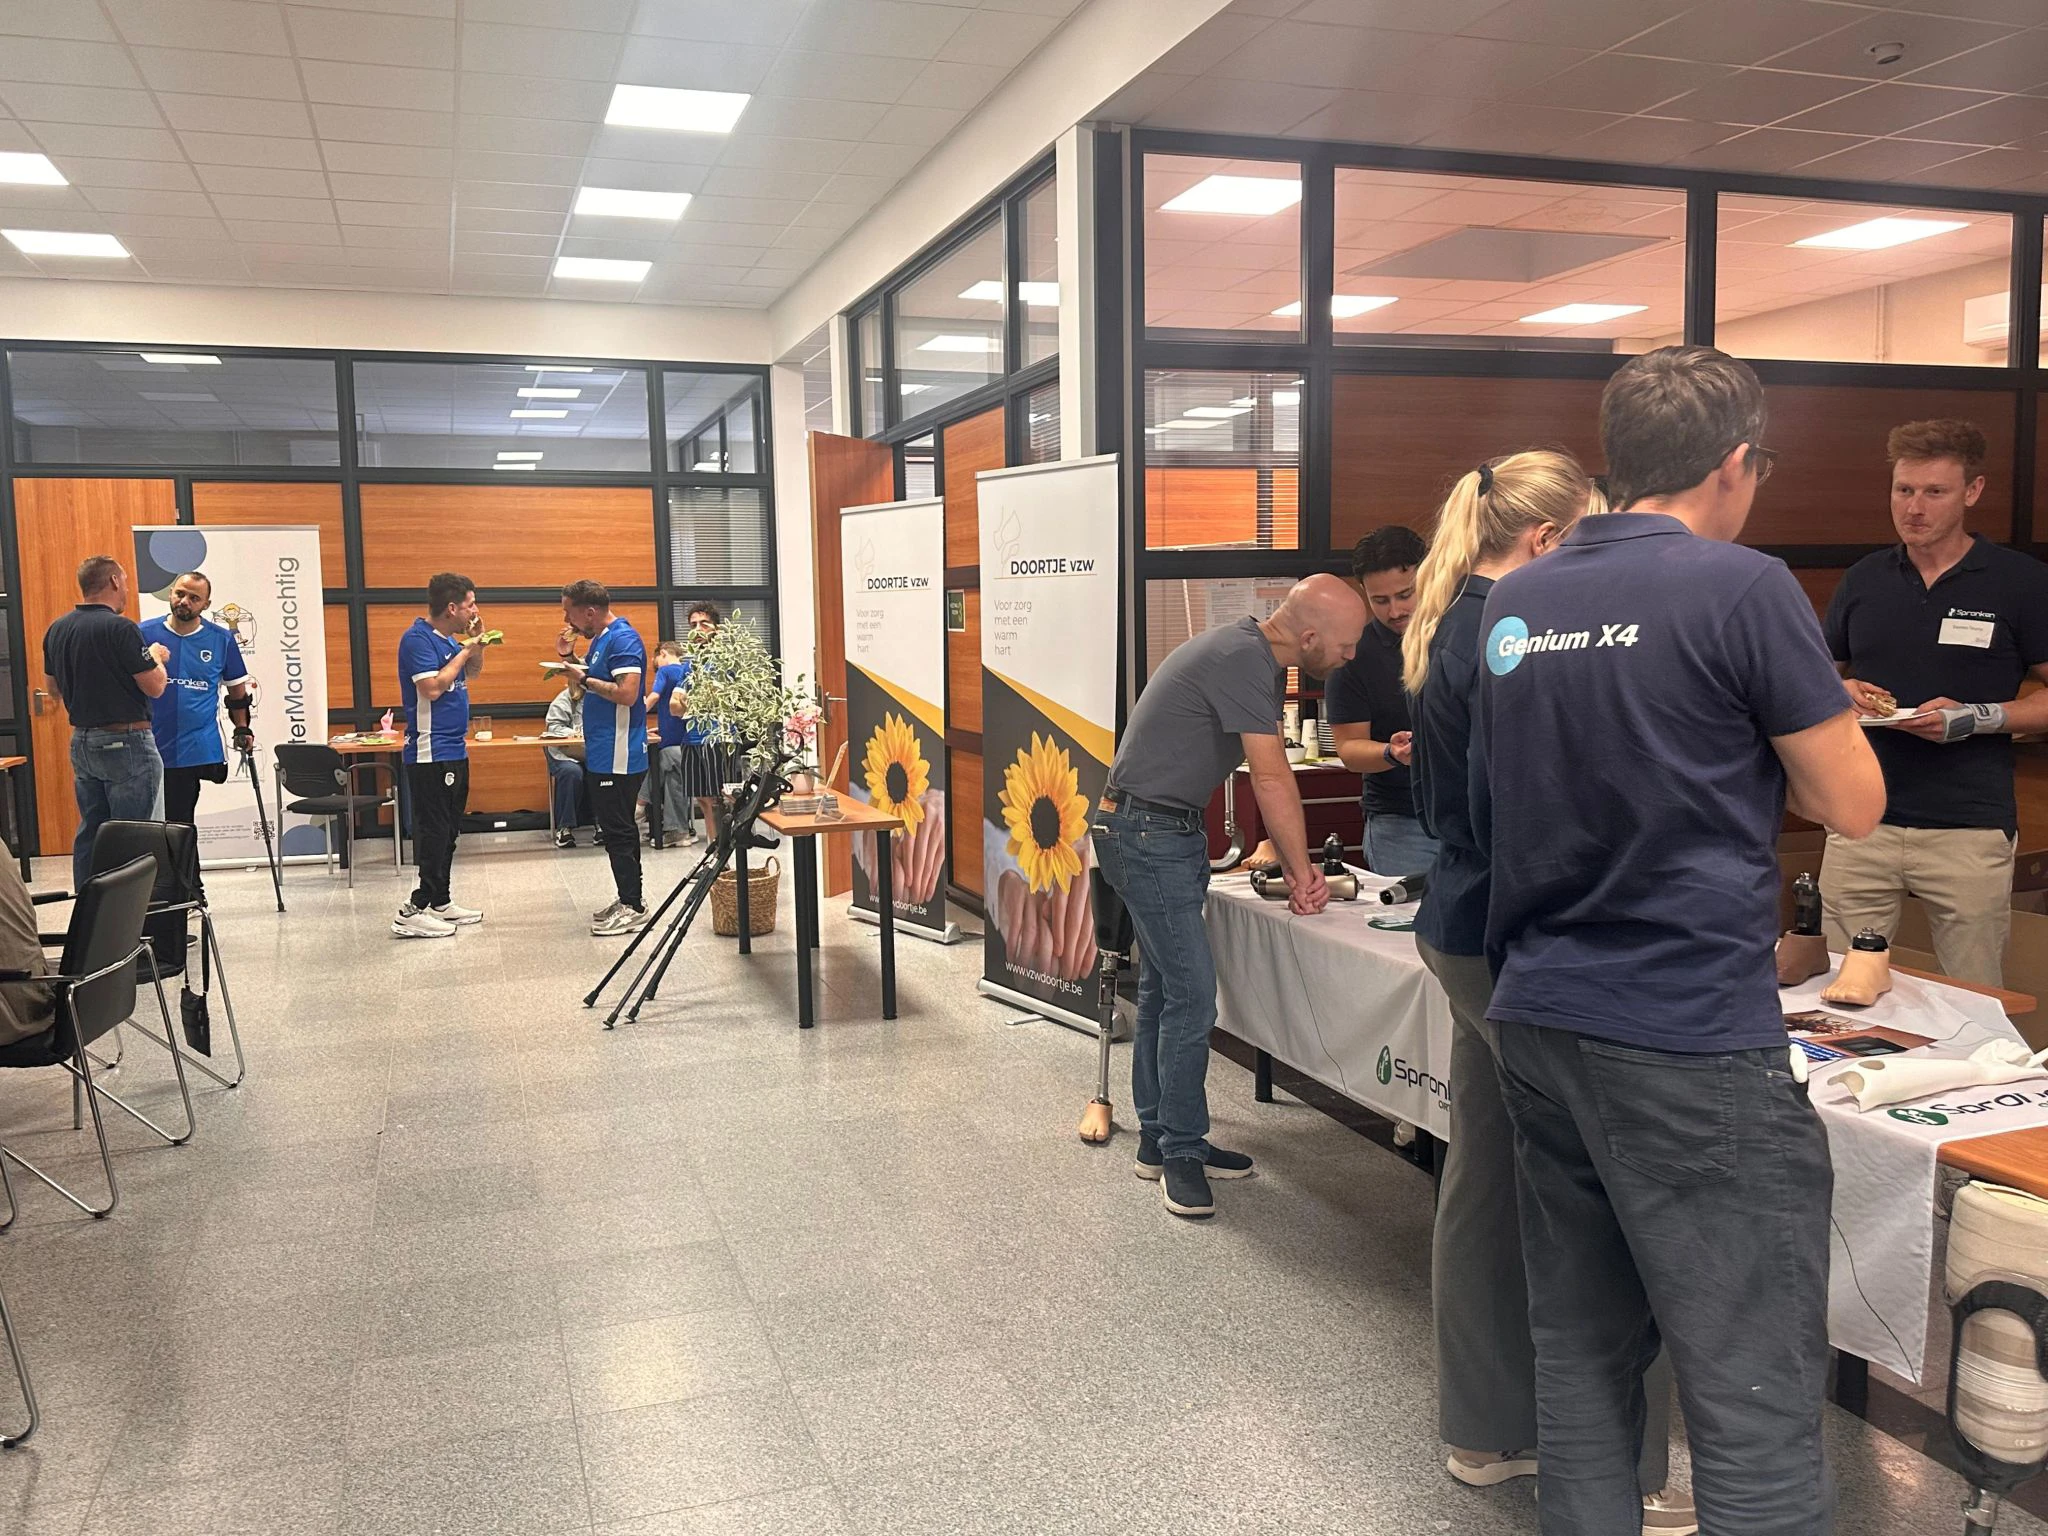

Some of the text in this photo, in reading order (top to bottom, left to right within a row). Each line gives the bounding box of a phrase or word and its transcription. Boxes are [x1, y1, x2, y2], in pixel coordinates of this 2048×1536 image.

[1011, 558, 1066, 575] DOORTJE
[867, 576, 908, 589] DOORTJE
[994, 600, 1032, 612] Voor zorg
[994, 616, 1028, 626] met een
[994, 631, 1018, 641] warm
[1499, 624, 1640, 657] Genium X4
[275, 557, 306, 745] terMaarKrachtig
[994, 644, 1011, 656] hart
[166, 678, 208, 689] ronken
[1005, 962, 1083, 995] www.vzwdoortje.be
[1394, 1058, 1452, 1101] Spron
